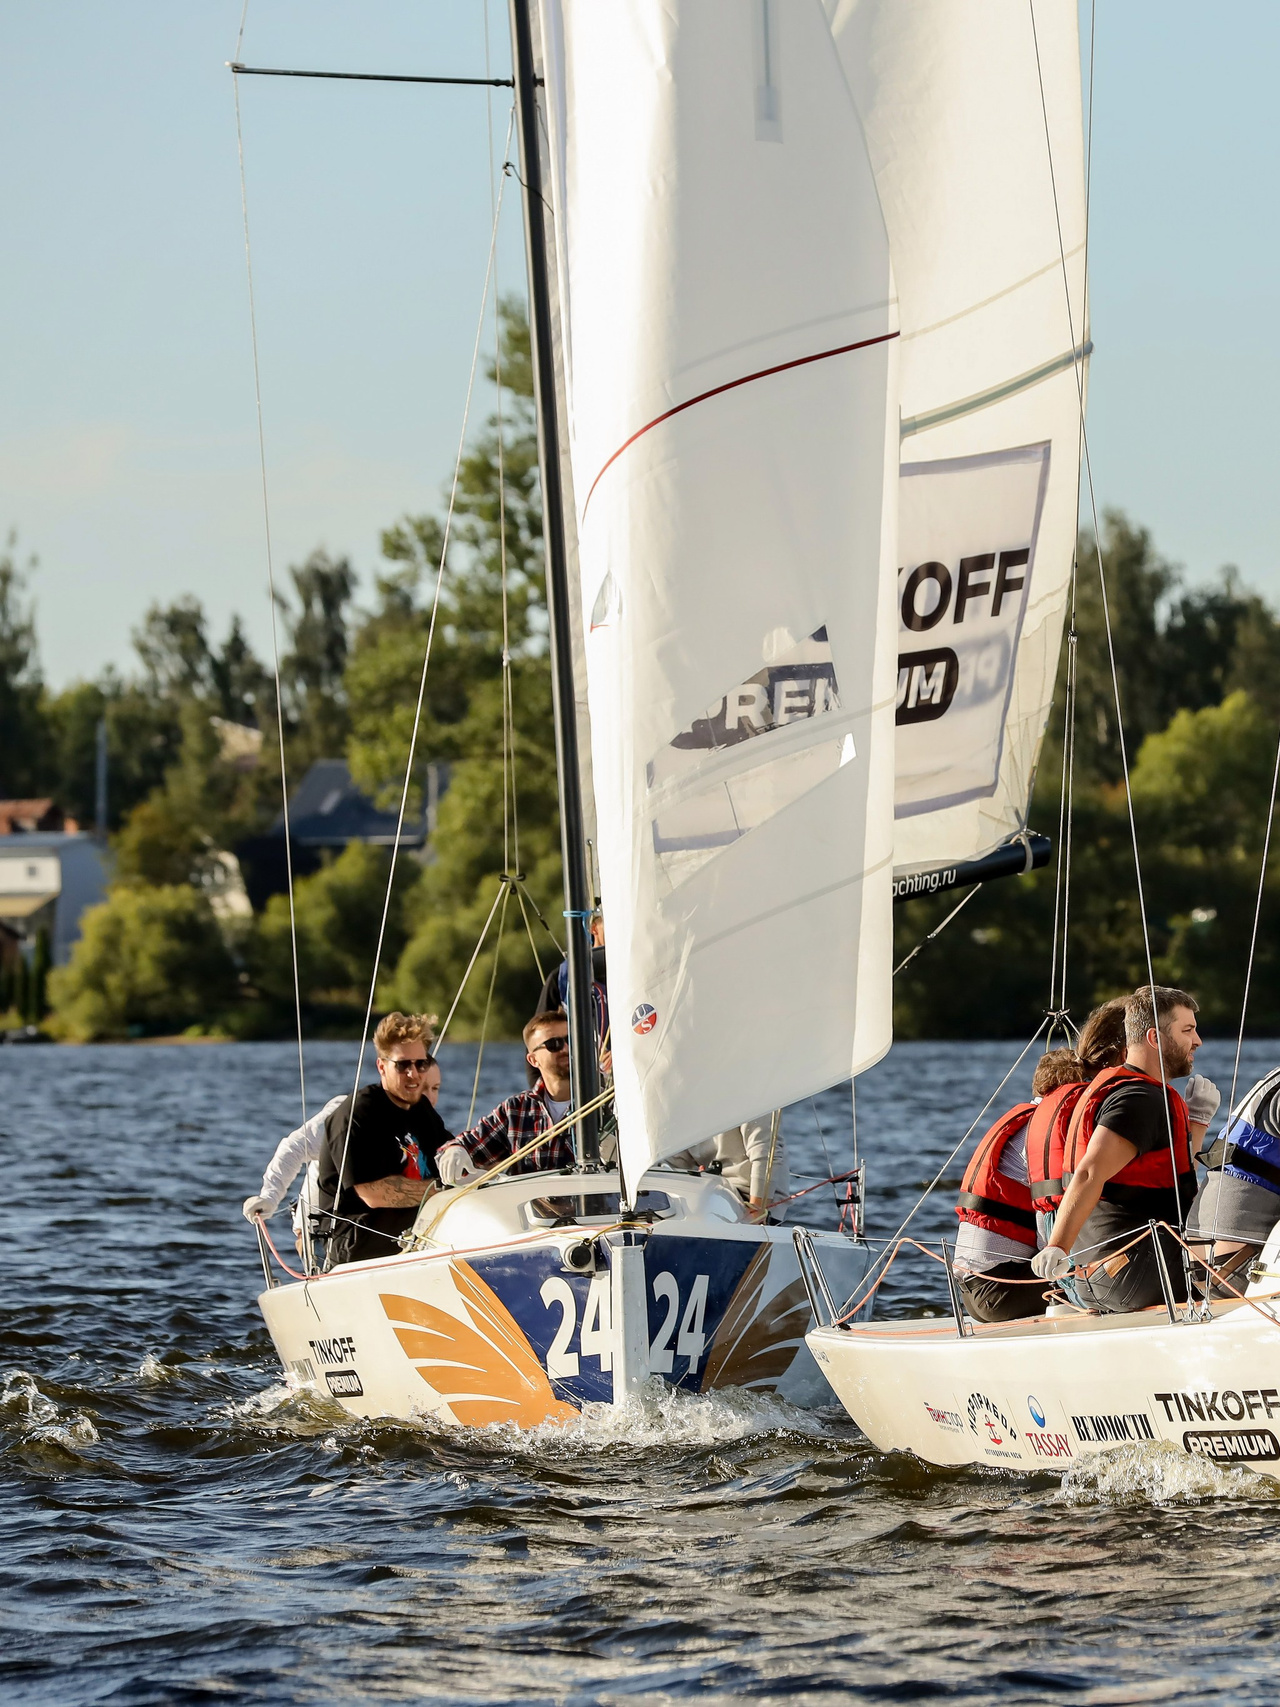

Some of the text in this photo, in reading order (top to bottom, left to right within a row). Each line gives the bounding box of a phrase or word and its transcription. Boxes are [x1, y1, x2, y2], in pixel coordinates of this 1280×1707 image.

[898, 547, 1030, 632] OFF
[308, 1336, 357, 1365] TINKOFF
[539, 1269, 616, 1380] 24
[649, 1271, 710, 1374] 24
[1025, 1432, 1073, 1457] TASSAY
[1187, 1434, 1277, 1458] PREMIUM
